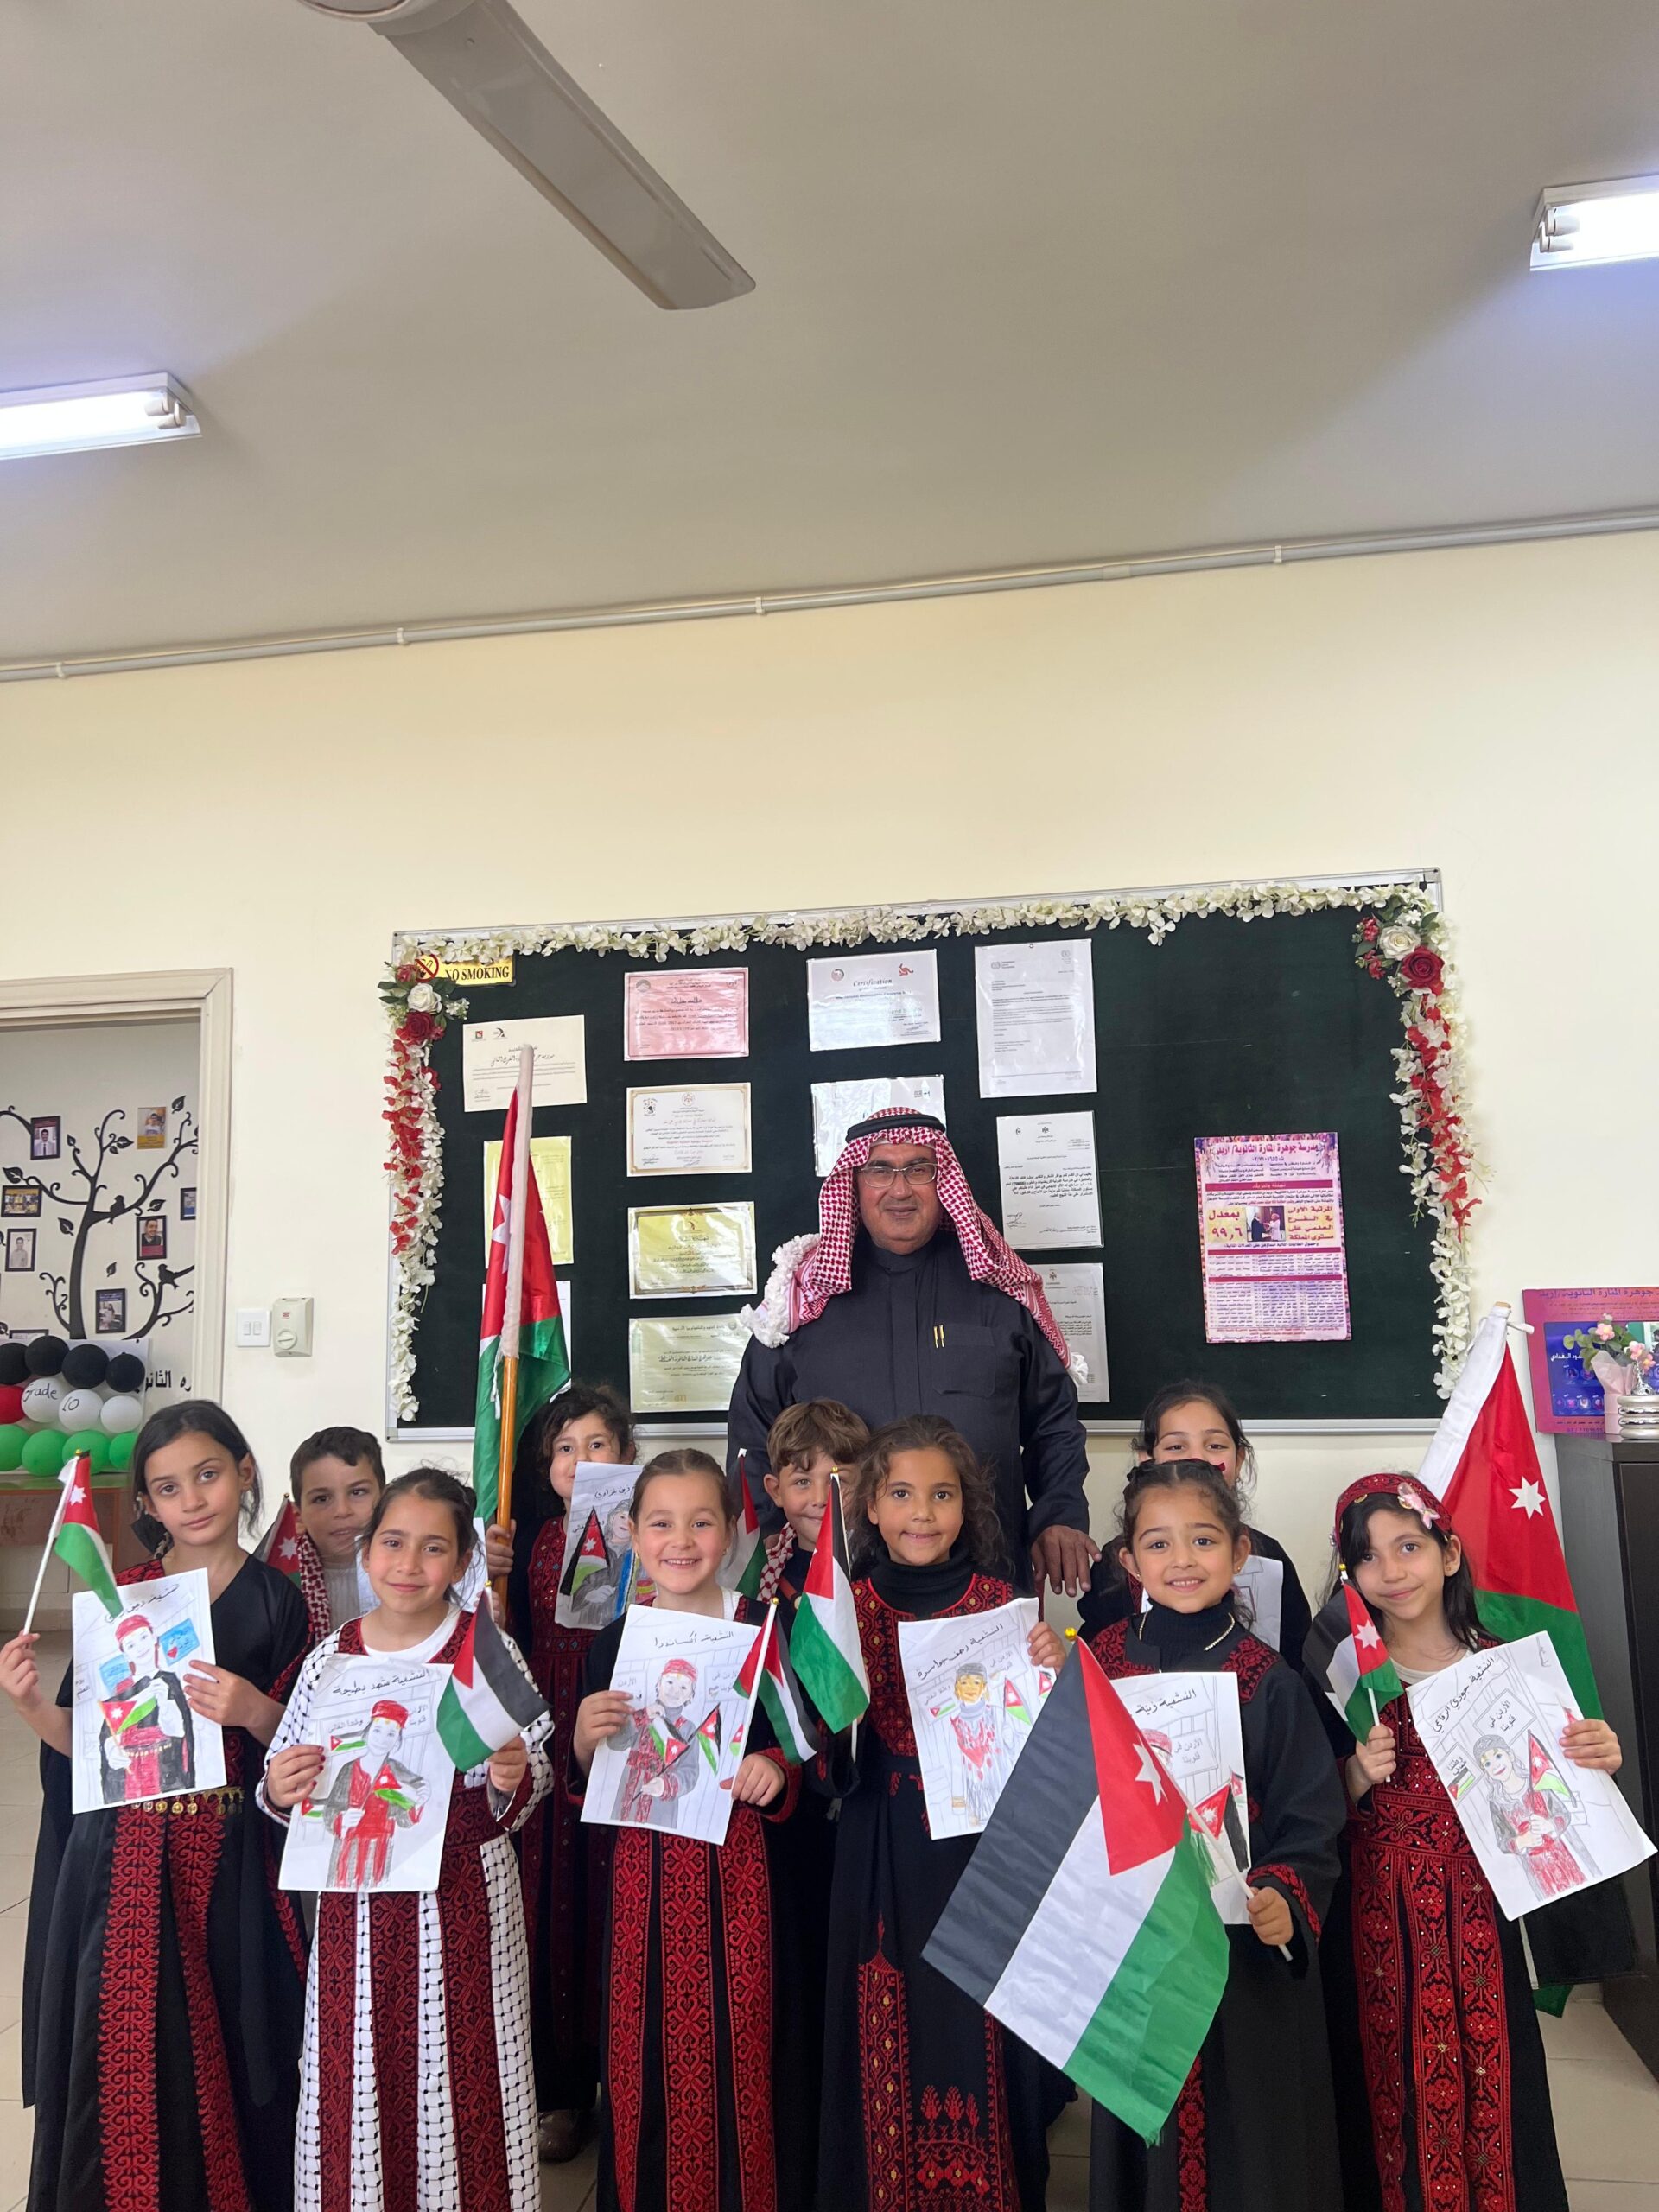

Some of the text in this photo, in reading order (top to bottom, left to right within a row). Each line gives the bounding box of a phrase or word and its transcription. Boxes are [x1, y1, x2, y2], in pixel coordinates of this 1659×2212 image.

[461, 966, 510, 981] SMOKING
[853, 978, 893, 988] Certification
[1277, 1143, 1297, 1154] جوهرة
[1299, 1142, 1319, 1154] مدرسة
[1208, 1209, 1240, 1221] بمعدل
[62, 1398, 79, 1411] 10
[1469, 1656, 1495, 1683] النشمية
[371, 1676, 391, 1691] شهد
[1135, 1688, 1197, 1715] النشمية زينة
